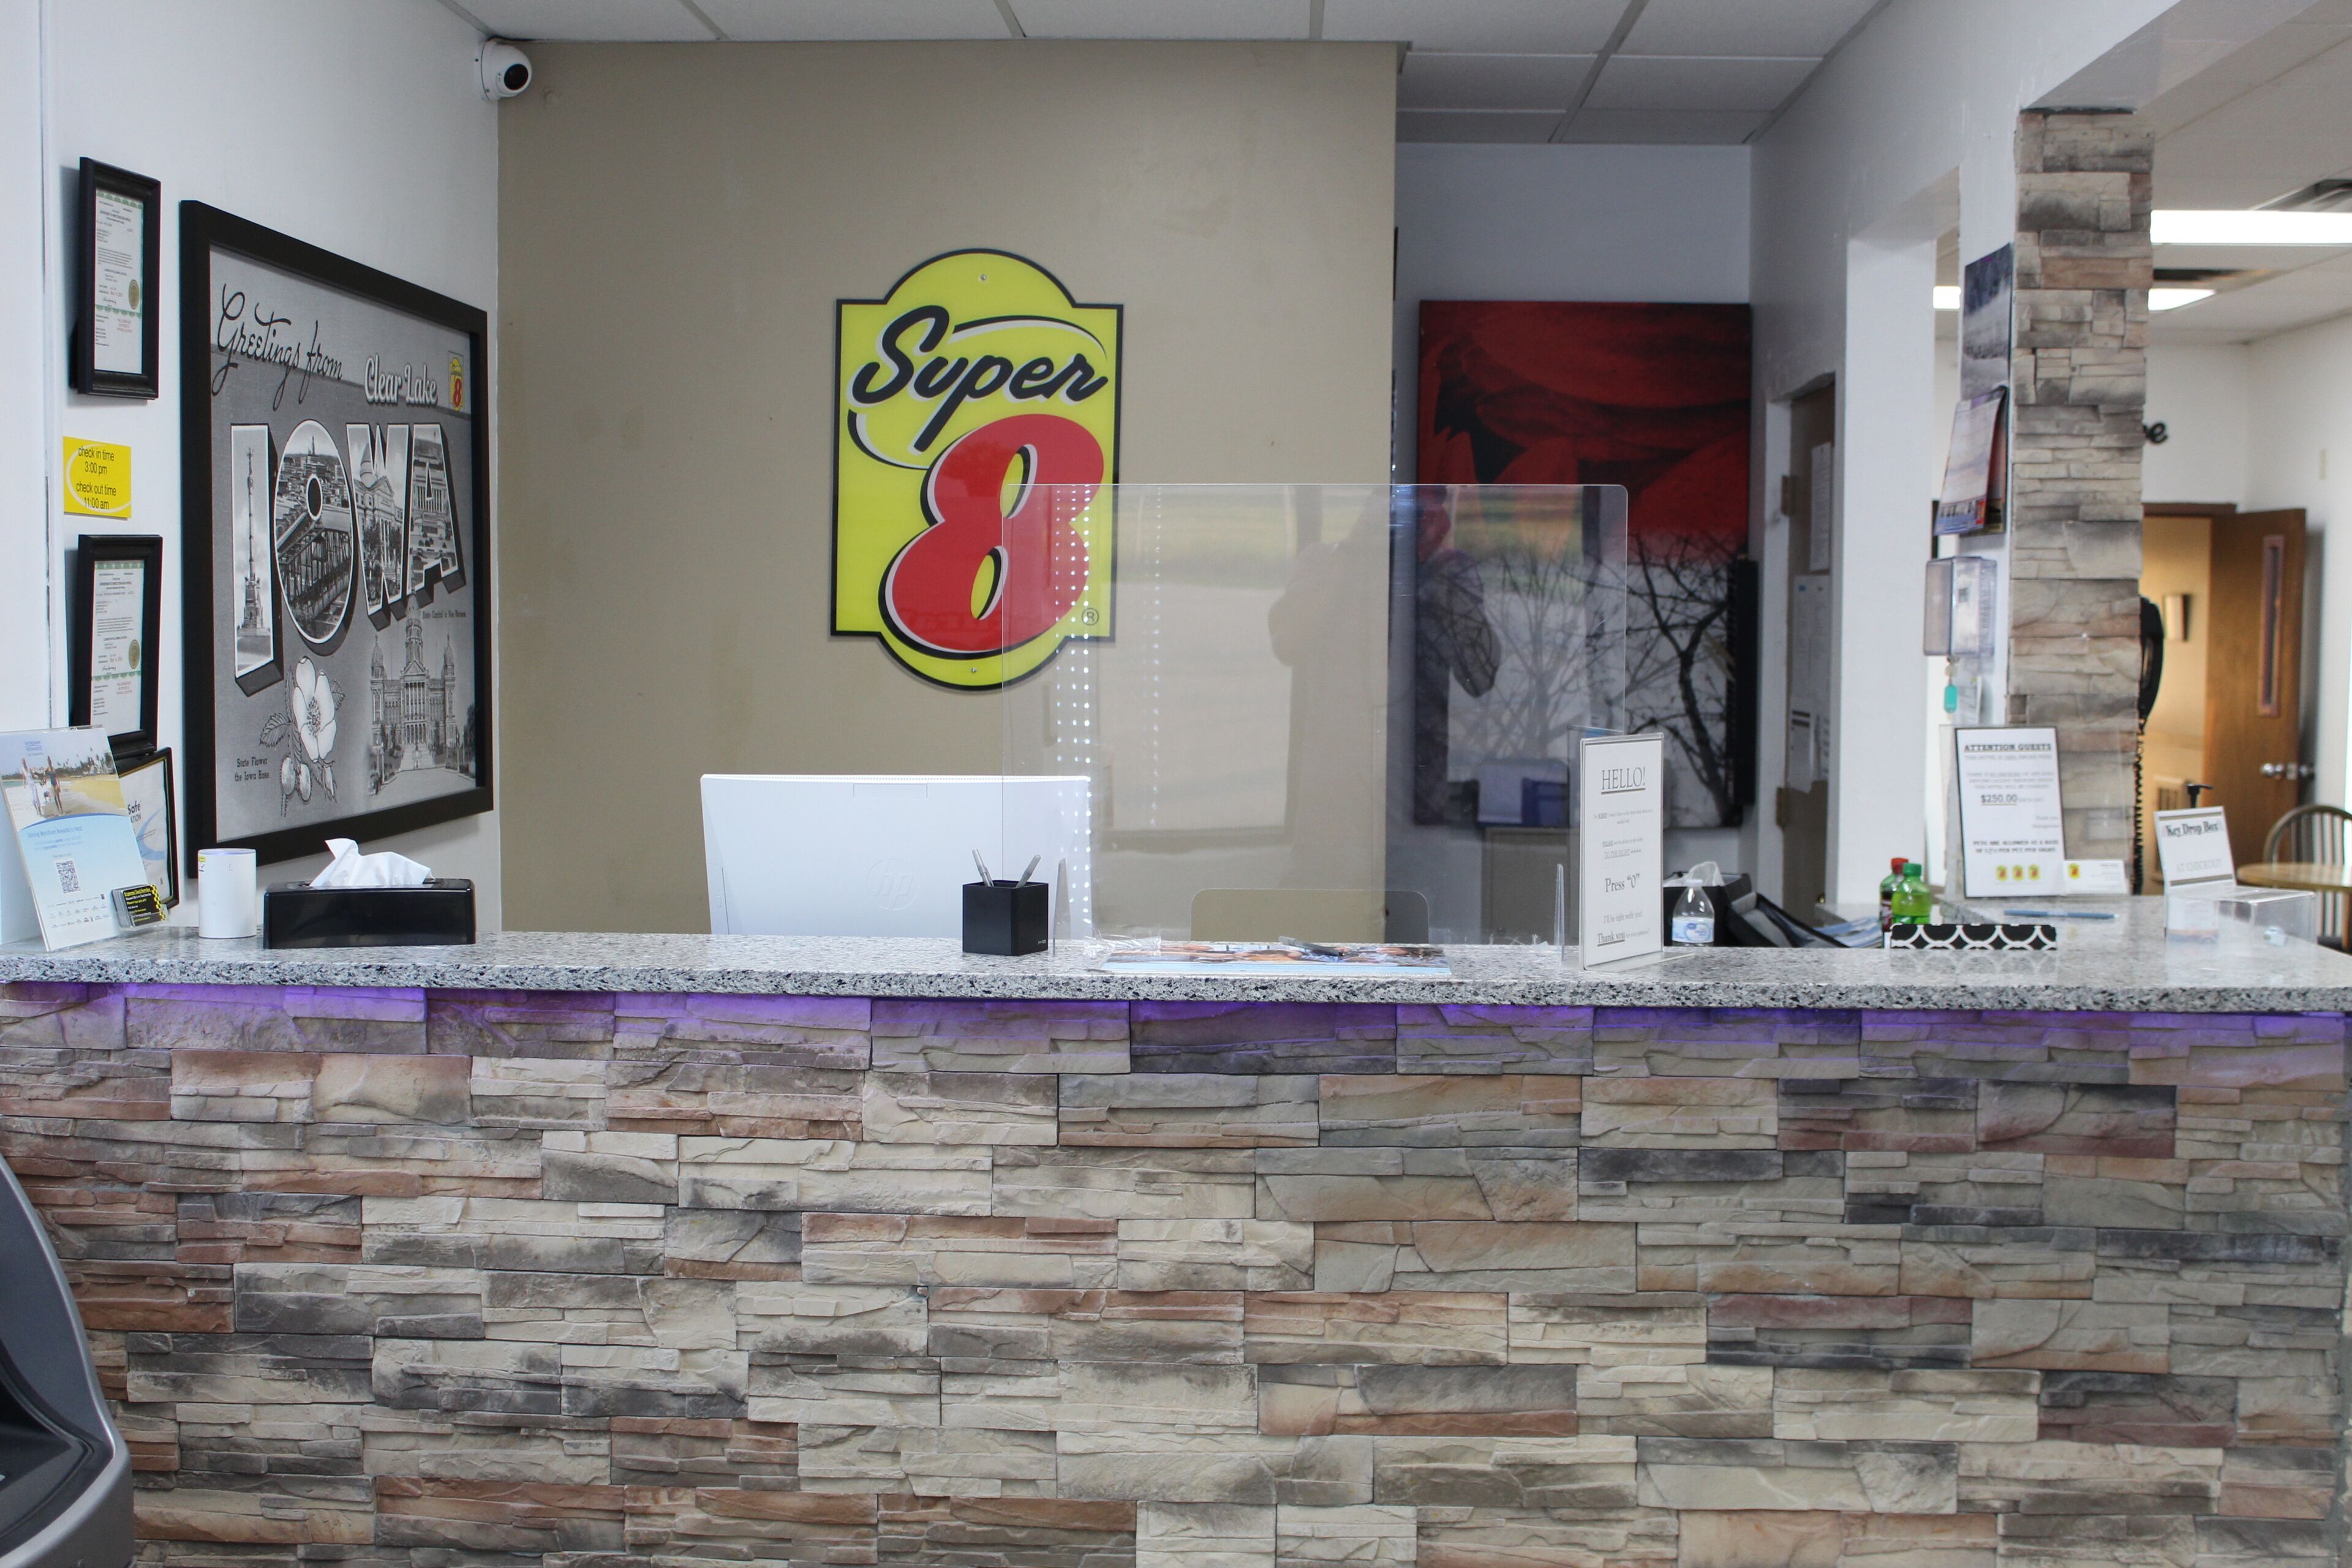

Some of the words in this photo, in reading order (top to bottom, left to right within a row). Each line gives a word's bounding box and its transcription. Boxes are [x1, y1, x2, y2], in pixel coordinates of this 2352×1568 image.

[212, 284, 301, 411] Greetings
[298, 320, 342, 404] from
[364, 352, 403, 405] Clear
[404, 364, 439, 405] Lake
[846, 305, 1108, 454] Super
[78, 446, 95, 459] check
[96, 450, 101, 459] in
[102, 450, 115, 461] time
[85, 461, 97, 473] 3:00
[99, 466, 108, 476] pm
[76, 481, 93, 494] check
[94, 484, 104, 495] out
[105, 484, 117, 497] time
[84, 497, 99, 509] 11:00
[100, 500, 110, 510] am
[878, 413, 1104, 660] 8
[231, 419, 464, 692] IOWA
[251, 756, 268, 766] Flower
[1602, 766, 1645, 790] HELLO!
[1980, 794, 2018, 804] $250.00
[127, 801, 141, 815] Safe
[2166, 825, 2180, 838] Key
[2182, 823, 2202, 836] Drop
[870, 859, 916, 910] hp
[1605, 877, 1625, 892] Press
[1597, 931, 1615, 944] Thank
[1616, 932, 1625, 941] you
